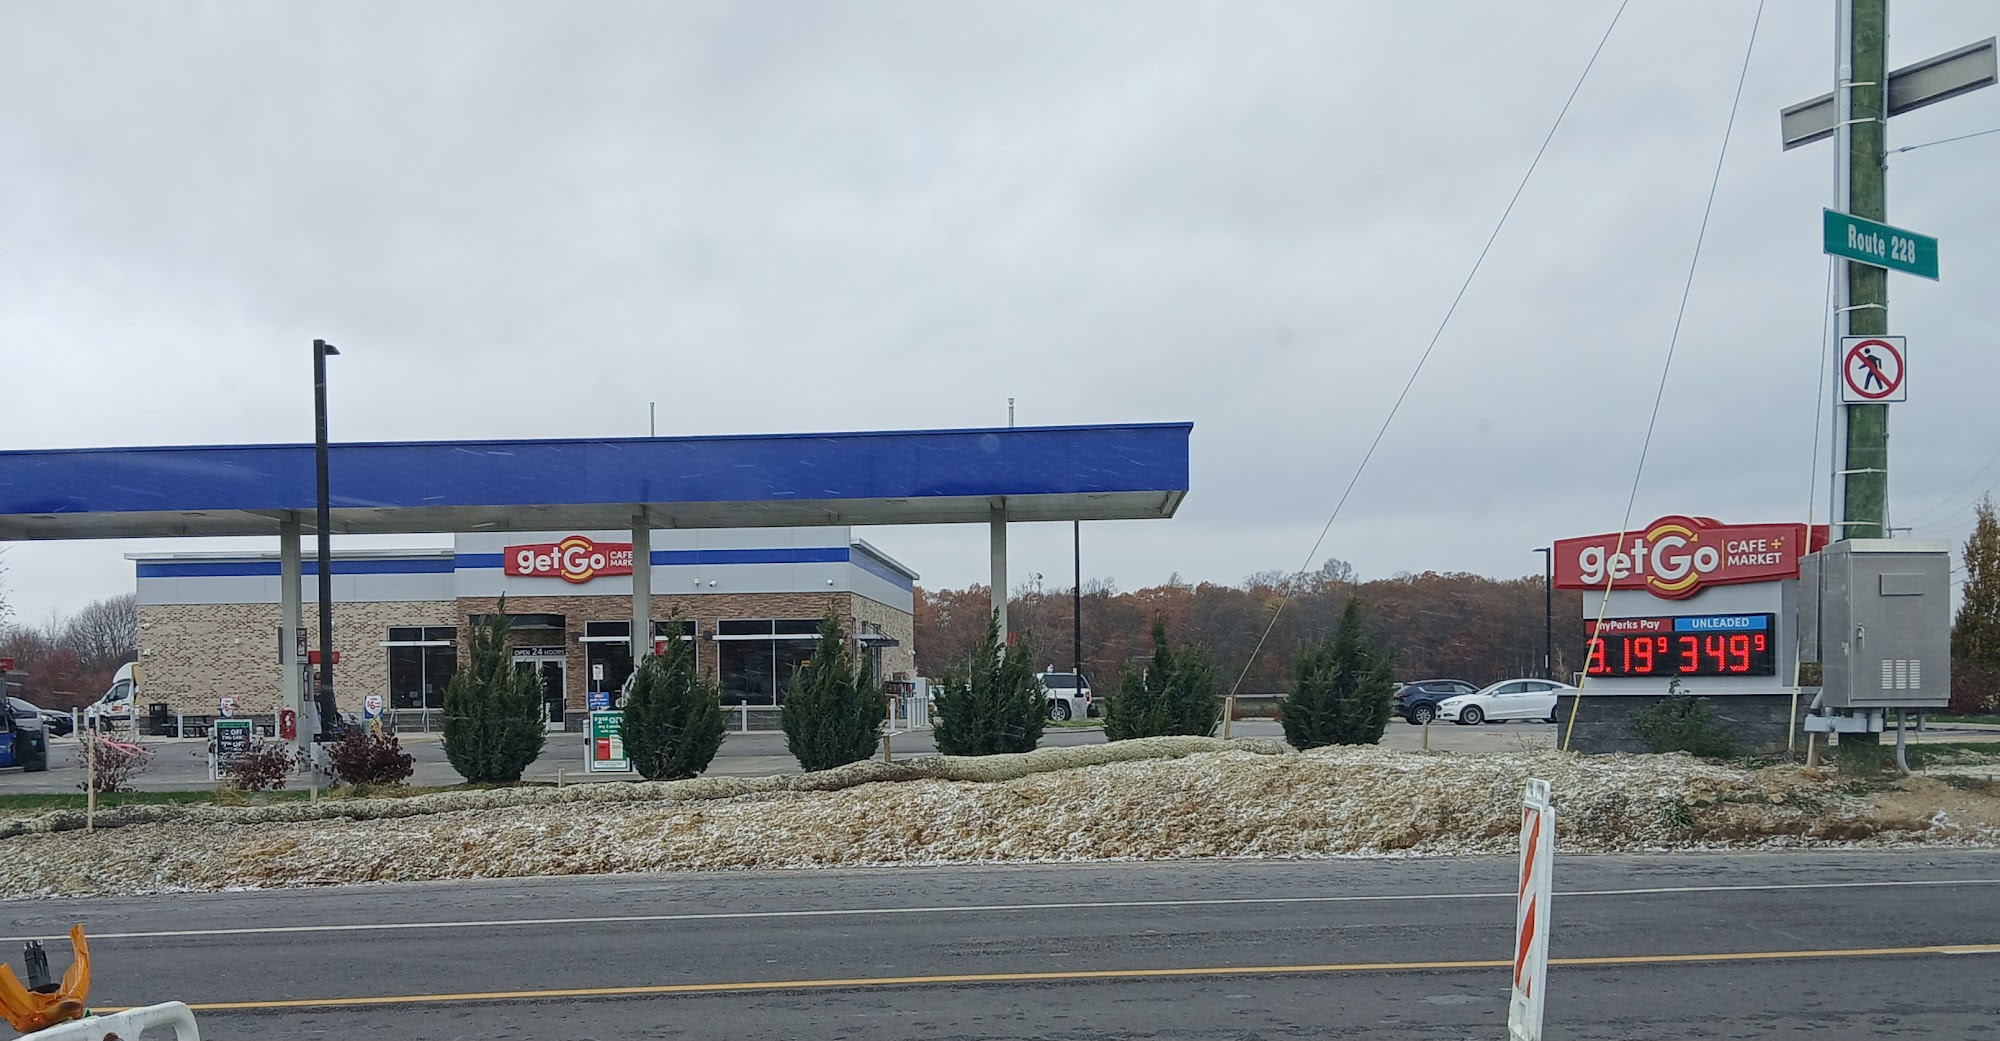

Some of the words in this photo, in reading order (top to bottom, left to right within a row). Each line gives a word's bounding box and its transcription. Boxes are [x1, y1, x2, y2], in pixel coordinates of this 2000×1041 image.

[1848, 223, 1885, 258] Route
[1891, 236, 1916, 264] 228
[1727, 539, 1767, 554] CAFE
[517, 546, 605, 574] getGo
[610, 550, 633, 559] CAFE
[1578, 536, 1719, 585] getGo
[1727, 552, 1782, 566] MARKET
[1641, 619, 1660, 631] Pay
[1692, 618, 1749, 629] UNLEADED
[531, 648, 543, 656] 24
